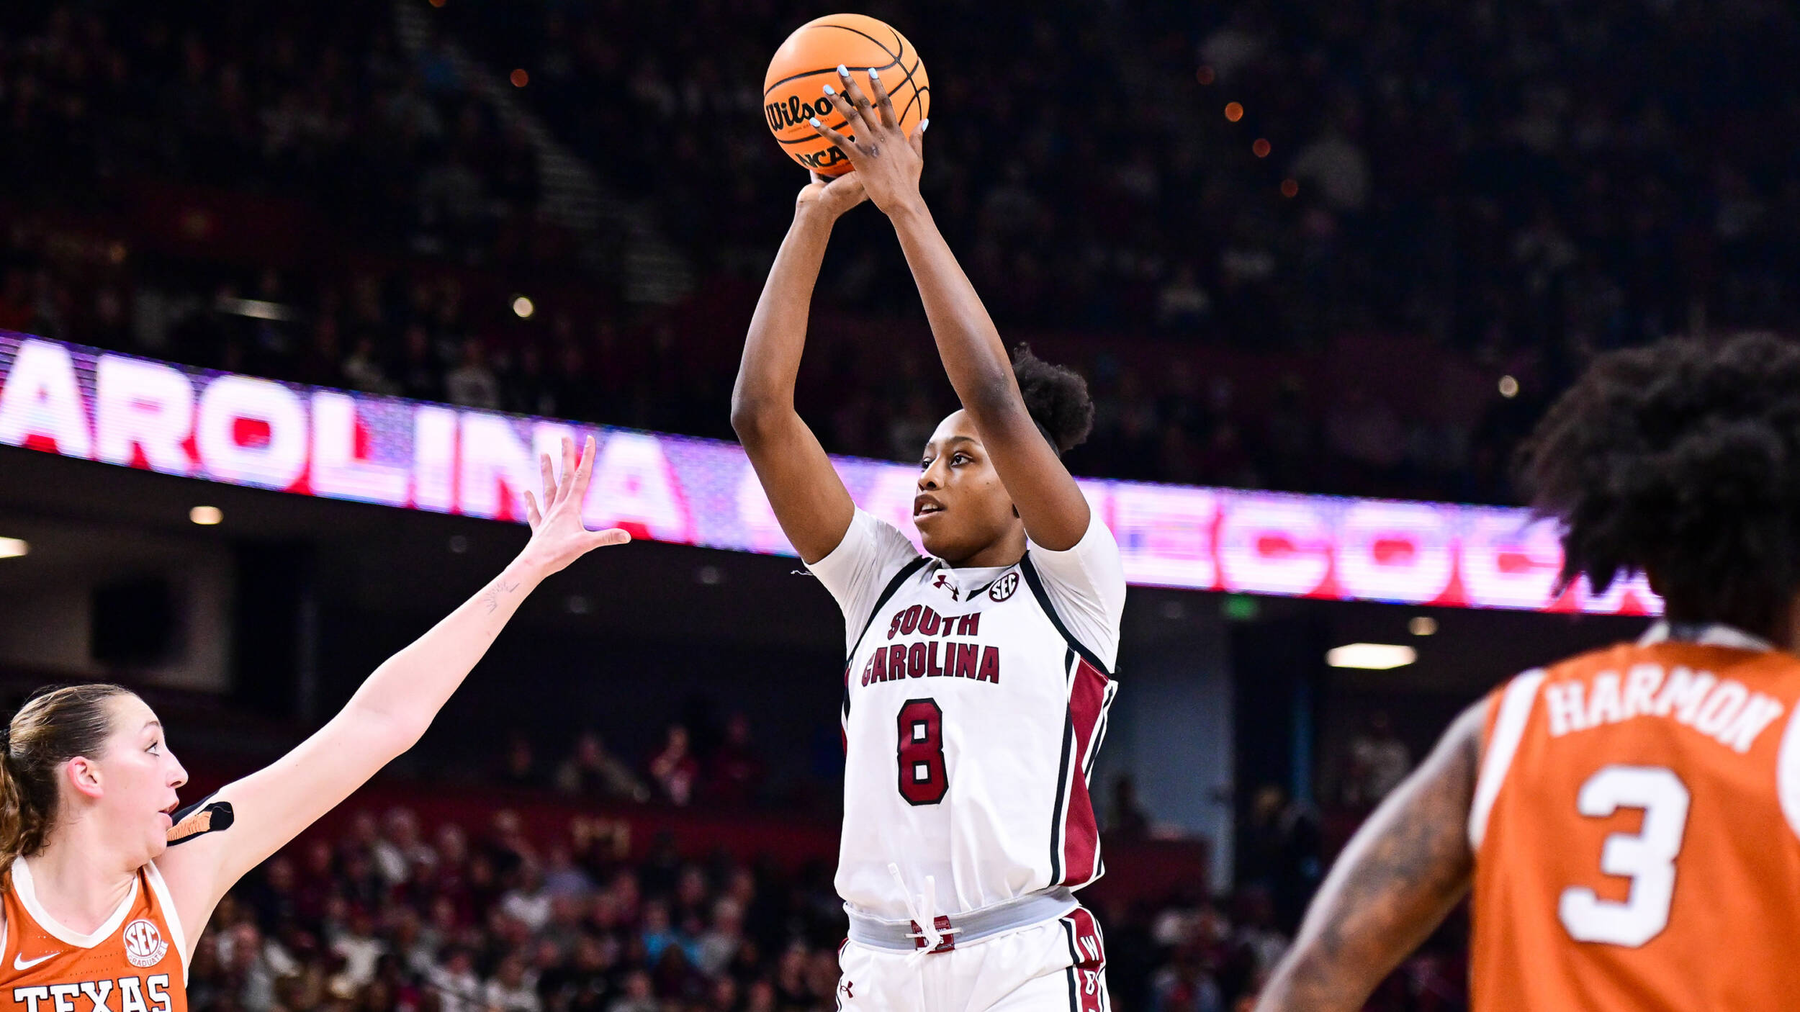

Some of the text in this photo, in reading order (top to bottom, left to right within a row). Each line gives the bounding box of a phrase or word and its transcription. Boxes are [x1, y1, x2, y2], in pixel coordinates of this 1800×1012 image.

[795, 136, 855, 168] NCA
[992, 574, 1016, 599] SEC
[887, 604, 981, 640] SOUTH
[861, 641, 1000, 687] CAROLINA
[1546, 663, 1784, 754] HARMON
[897, 698, 949, 806] 8
[1557, 764, 1691, 948] 3
[126, 922, 159, 957] SEC
[13, 973, 173, 1012] TEXAS
[1080, 935, 1100, 1012] WB
